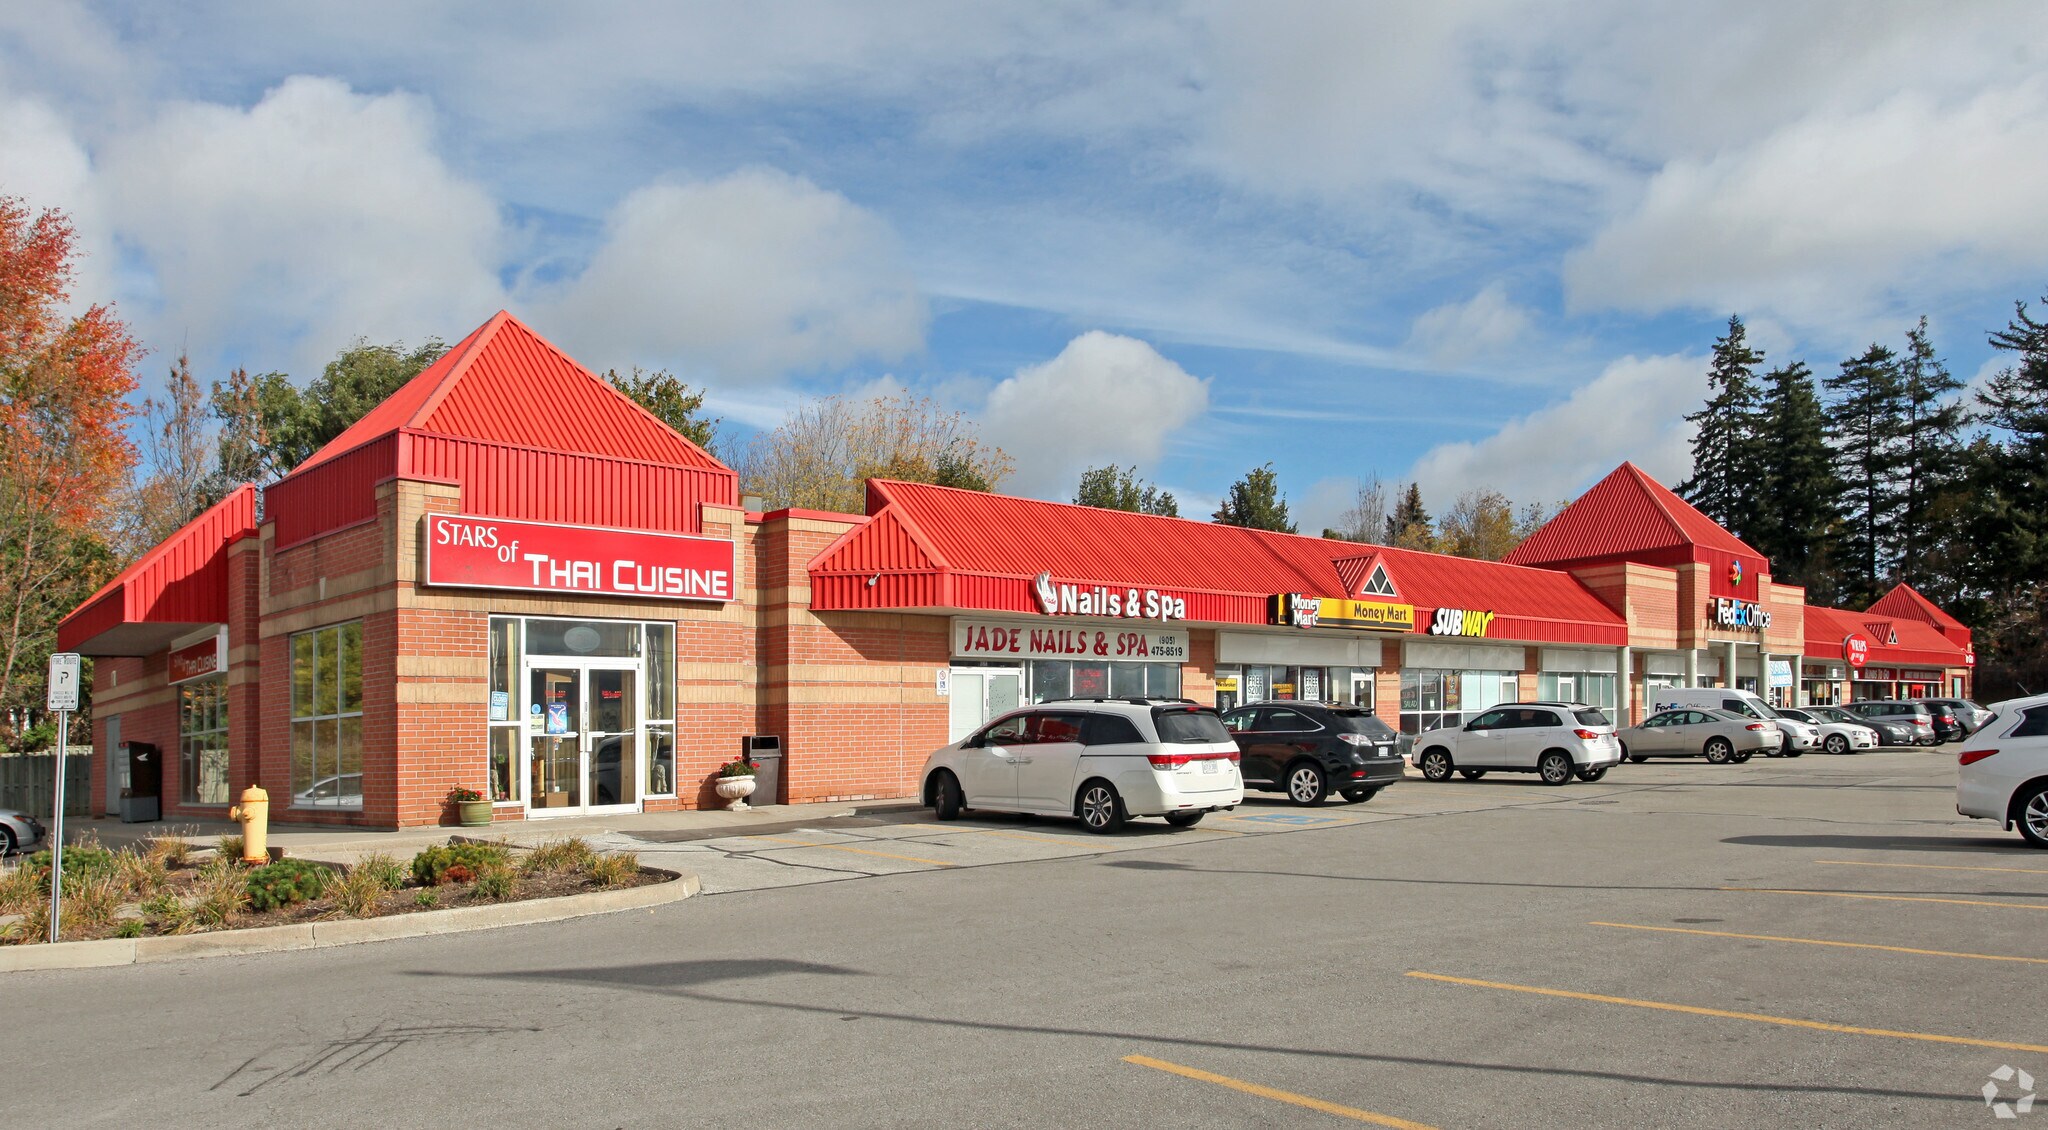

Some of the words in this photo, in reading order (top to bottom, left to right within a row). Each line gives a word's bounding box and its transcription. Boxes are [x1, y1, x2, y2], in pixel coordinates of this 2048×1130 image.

[437, 519, 498, 548] STARS
[498, 540, 519, 563] of
[523, 553, 601, 588] THAI
[612, 559, 728, 597] CUISINE
[1061, 584, 1121, 616] Nails
[1126, 588, 1141, 617] &
[1145, 590, 1185, 622] Spa
[1291, 593, 1322, 611] Money
[1293, 609, 1317, 626] Mart
[1354, 603, 1385, 624] Money
[1386, 606, 1407, 621] Mart
[1717, 597, 1747, 625] FedEx
[1746, 603, 1771, 628] Office
[1432, 607, 1494, 636] SUBWAY
[964, 625, 1022, 652] JADE
[1029, 629, 1087, 654] NAILS
[1093, 631, 1109, 656] &
[1116, 632, 1149, 657] SPA
[1158, 635, 1176, 645] (905)
[1850, 639, 1867, 652] WRAPS
[1150, 646, 1183, 657] 475-8519
[1247, 675, 1262, 685] FREE
[1305, 675, 1318, 685] FREE
[1247, 685, 1262, 695] $200
[1305, 685, 1318, 695] $200
